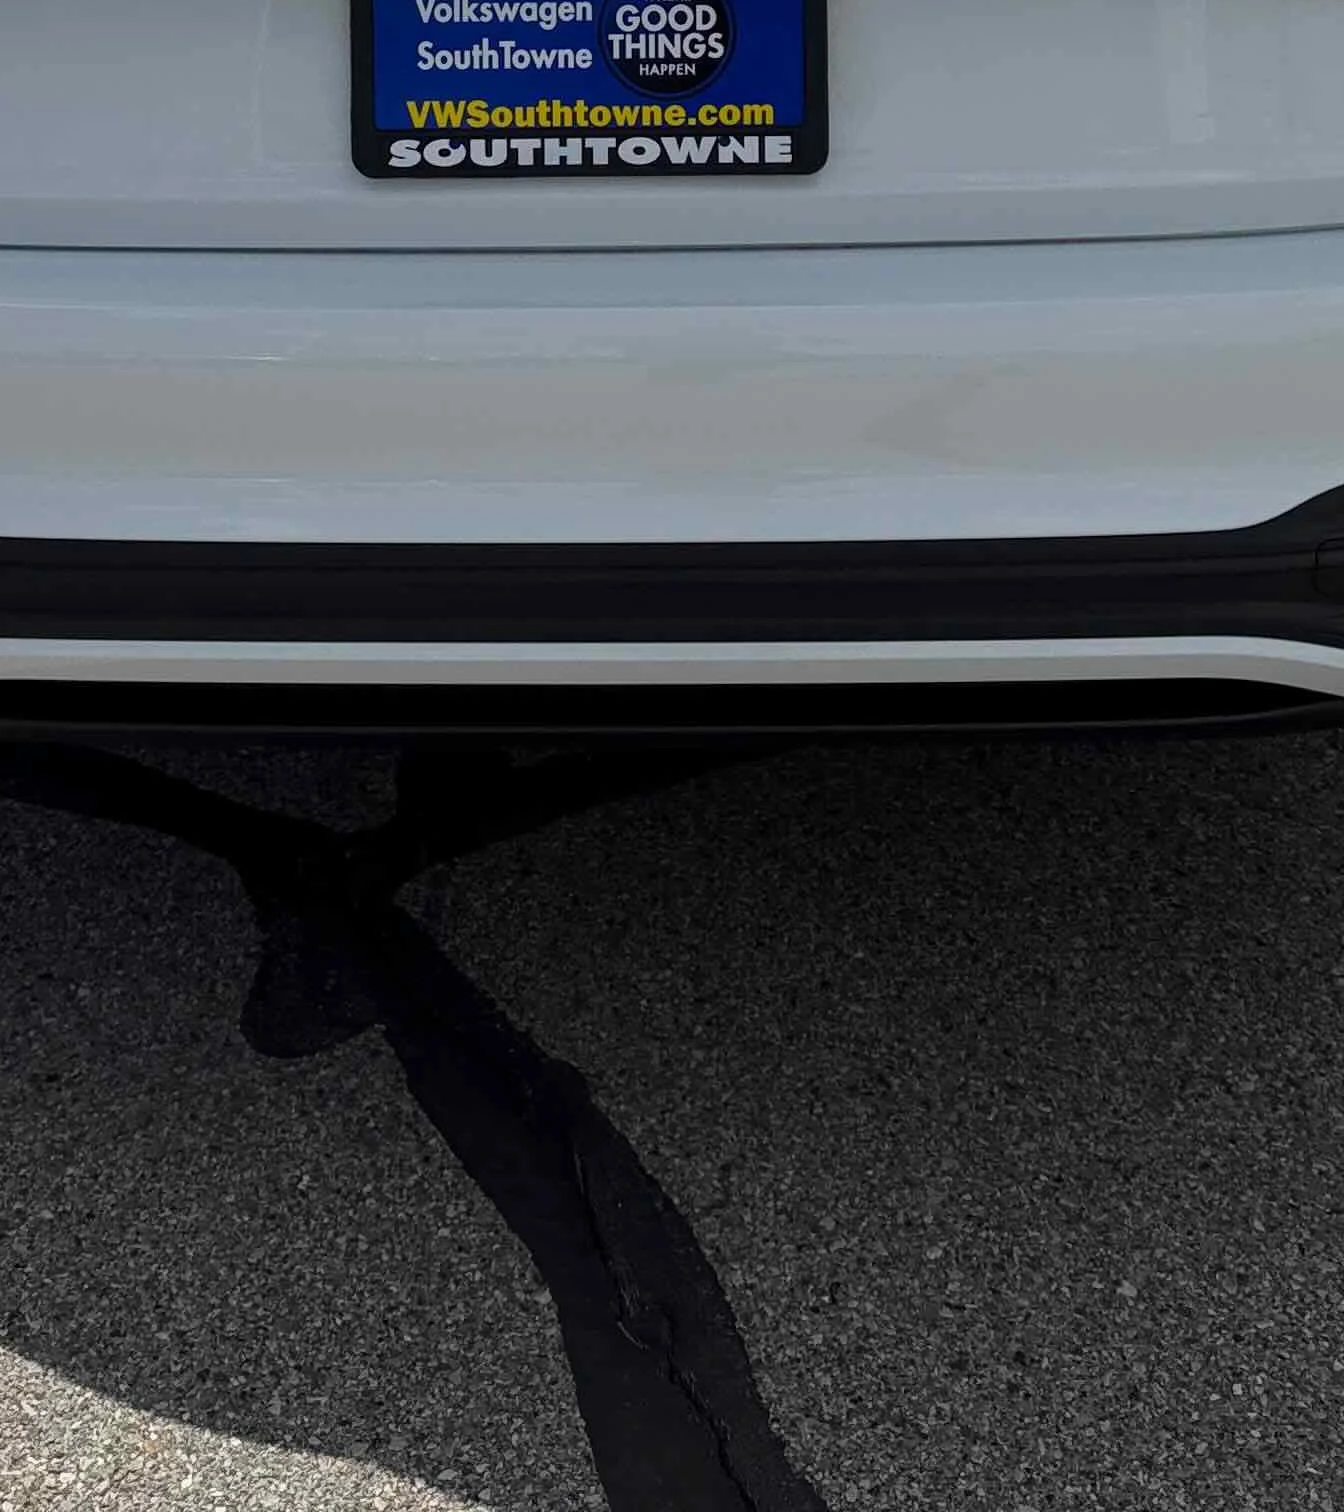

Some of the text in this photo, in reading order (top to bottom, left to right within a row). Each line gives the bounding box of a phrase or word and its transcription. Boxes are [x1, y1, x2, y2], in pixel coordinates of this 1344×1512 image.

[614, 4, 717, 33] GOOD
[416, 39, 593, 71] SouthTowne
[607, 32, 725, 61] THINGS
[638, 63, 697, 77] HAPPEN
[406, 99, 775, 130] VWSouthtowne.com
[388, 136, 793, 169] SOUTHTOWNE
